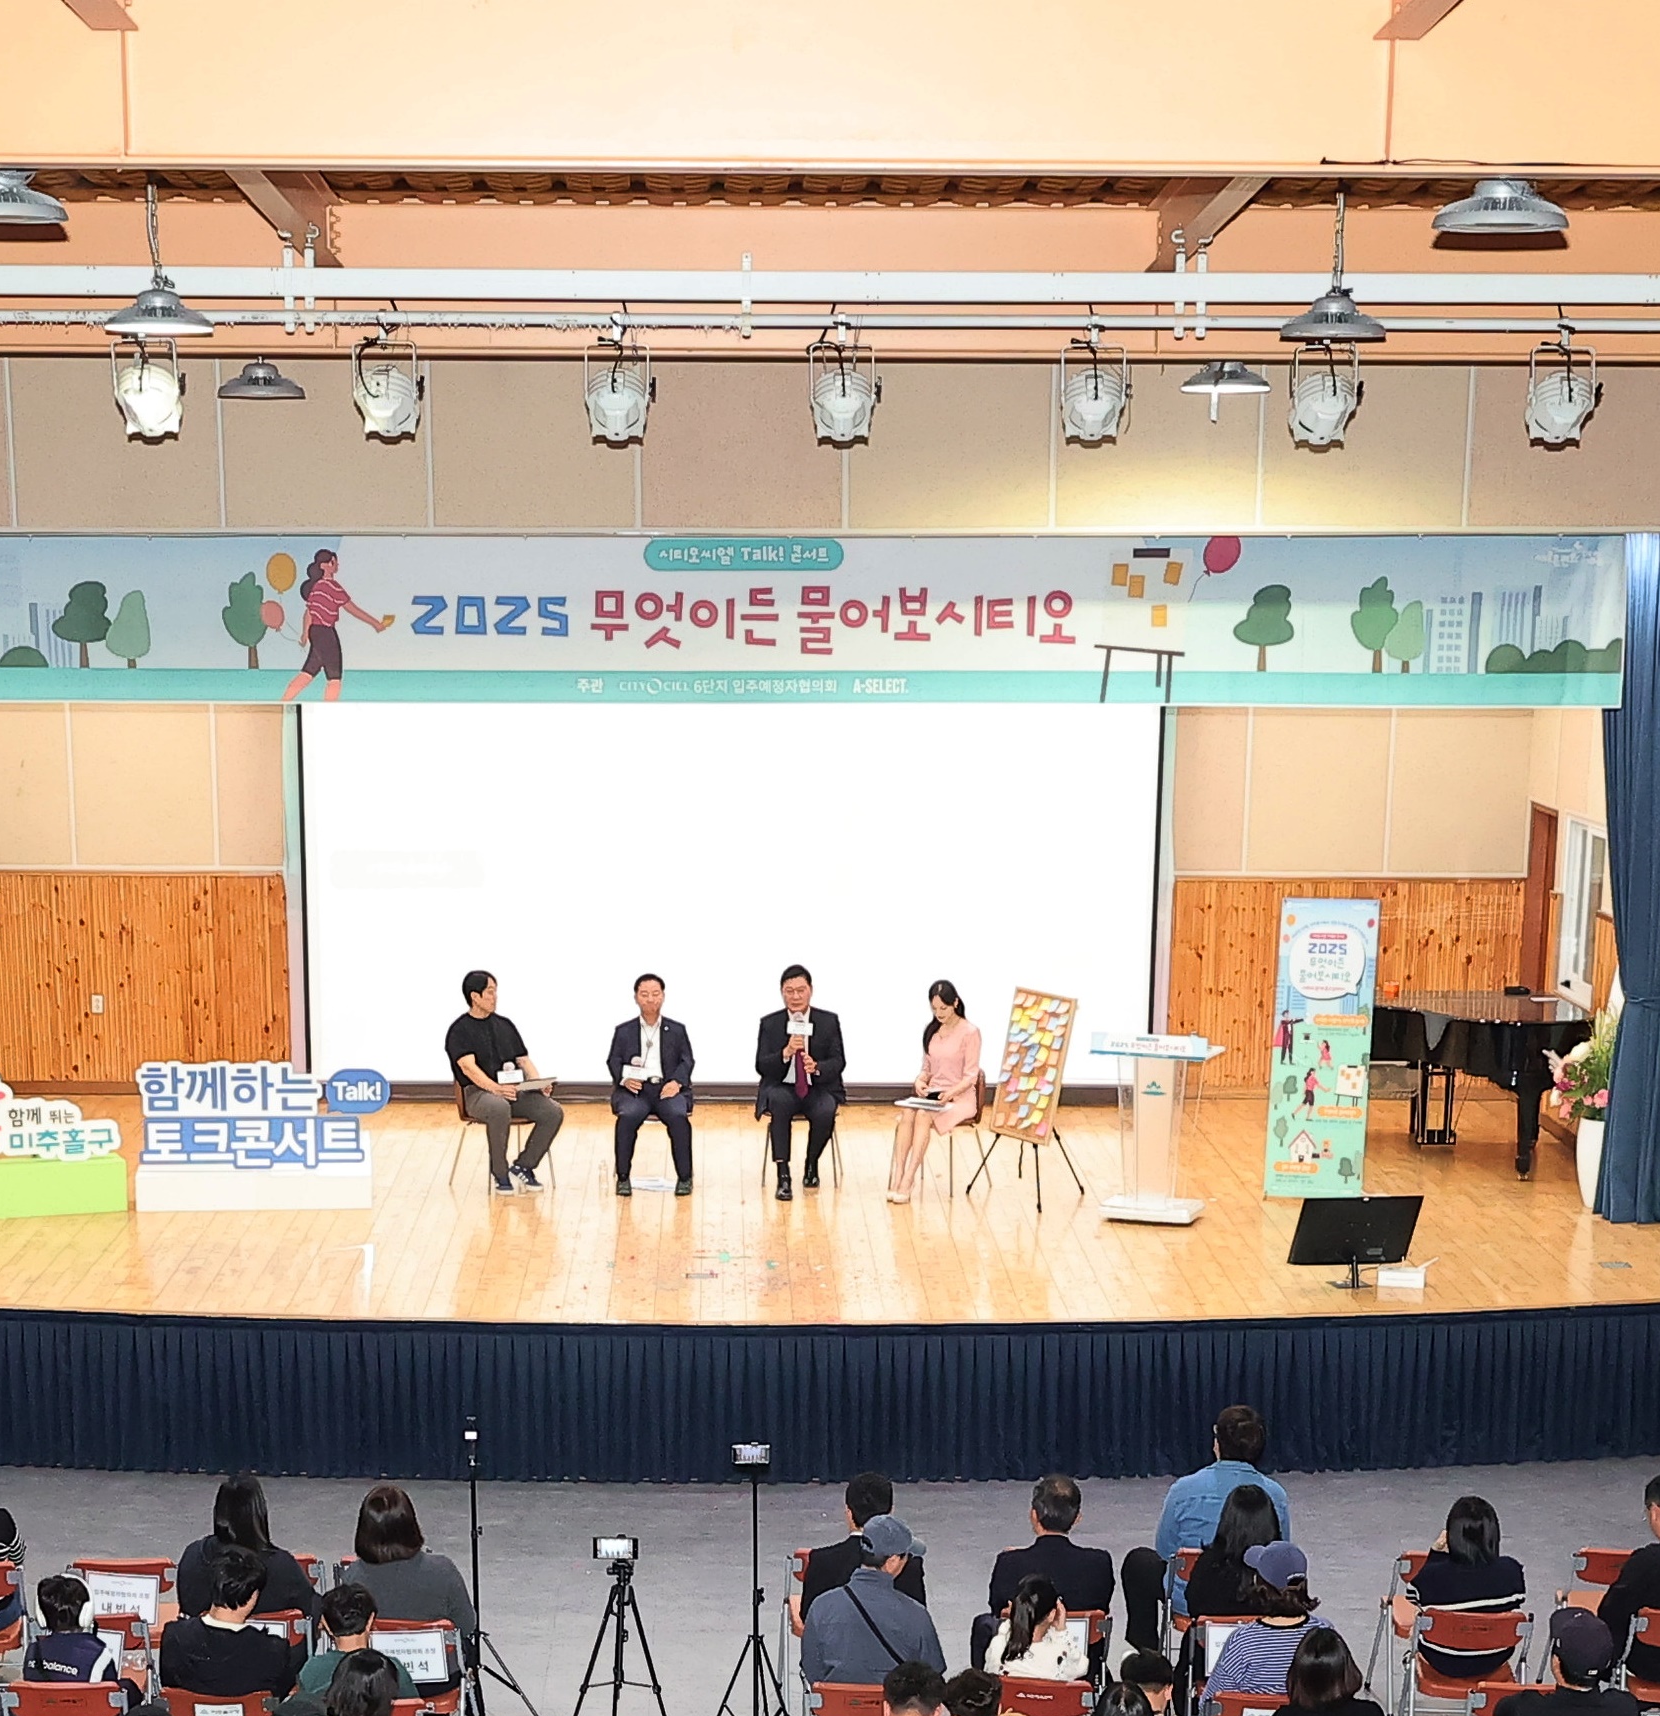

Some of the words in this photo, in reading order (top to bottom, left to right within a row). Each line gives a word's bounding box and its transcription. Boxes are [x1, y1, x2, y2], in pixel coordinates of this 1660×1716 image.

[659, 545, 735, 565] 시티오씨엘
[741, 545, 785, 562] Talk!
[790, 545, 829, 564] 콘서트
[411, 595, 569, 637] 2025
[590, 586, 779, 649] 무엇이든
[797, 585, 1076, 655] 물어보시티오
[577, 678, 604, 693] 주관
[693, 678, 728, 694] 6단지
[731, 678, 838, 694] 입주예정자협의회
[1308, 943, 1347, 955] 2025
[141, 1066, 317, 1112] 함께하는
[332, 1081, 382, 1103] Talk!
[8, 1107, 42, 1128] 함께
[49, 1108, 75, 1125] 뛰는
[10, 1129, 114, 1155] 미추홀구
[145, 1119, 363, 1167] 토크콘서트
[43, 1660, 78, 1677] balance
